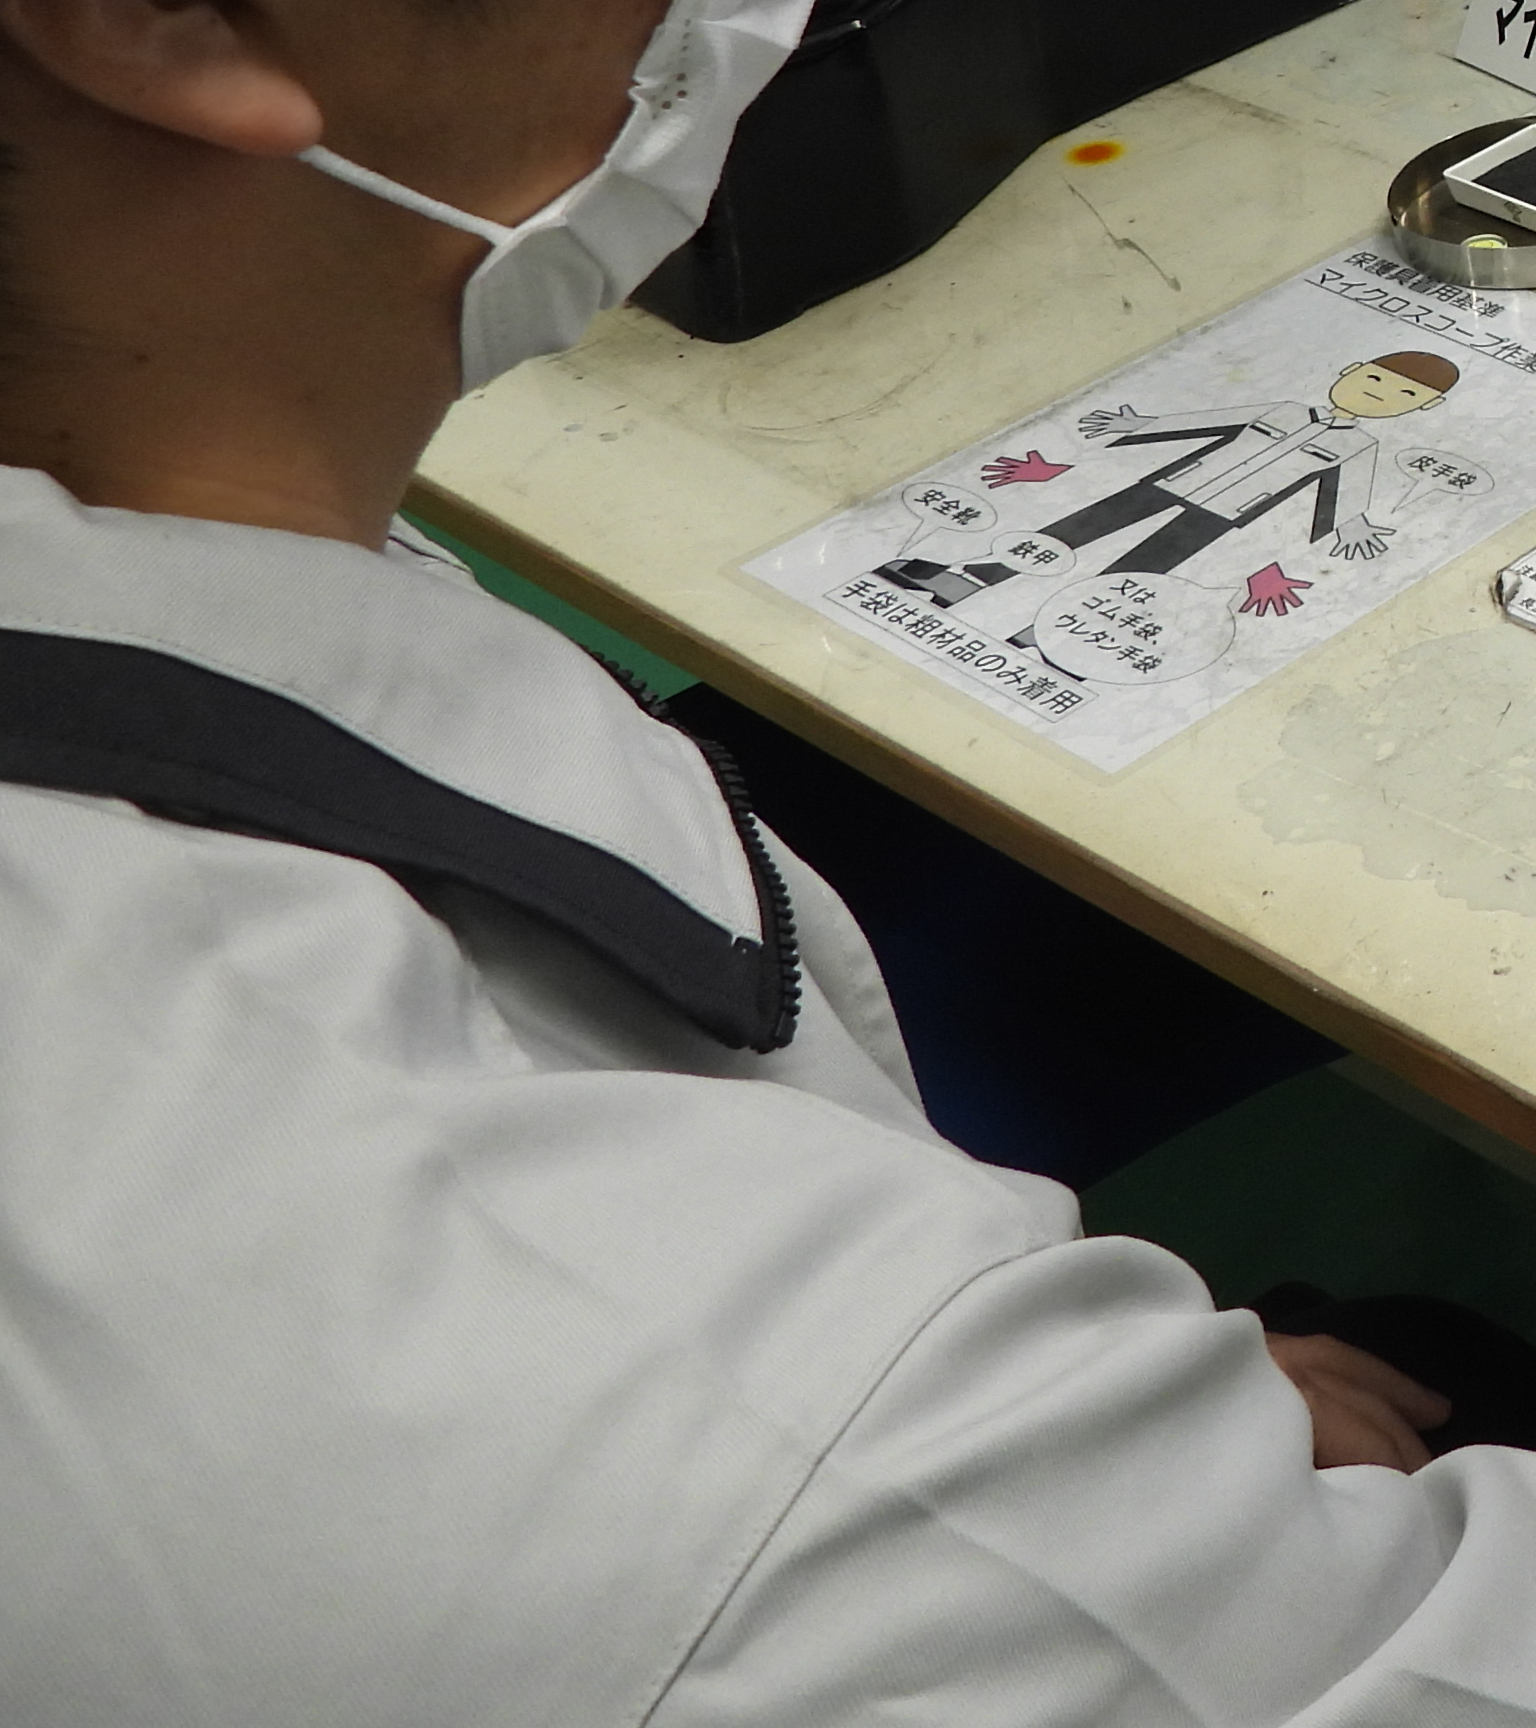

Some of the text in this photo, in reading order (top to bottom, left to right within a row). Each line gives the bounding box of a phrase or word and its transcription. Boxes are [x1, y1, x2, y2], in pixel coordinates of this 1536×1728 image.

[1342, 251, 1505, 320] 保護具着用基準
[1404, 448, 1478, 494] 皮手袋
[913, 487, 984, 527] 安全靴
[1109, 578, 1158, 606] 又は
[1054, 613, 1164, 675] ウレタン手袋
[1081, 593, 1164, 646] ゴム手袋、
[840, 578, 1084, 716] 手袋は粗材品のみ着用
